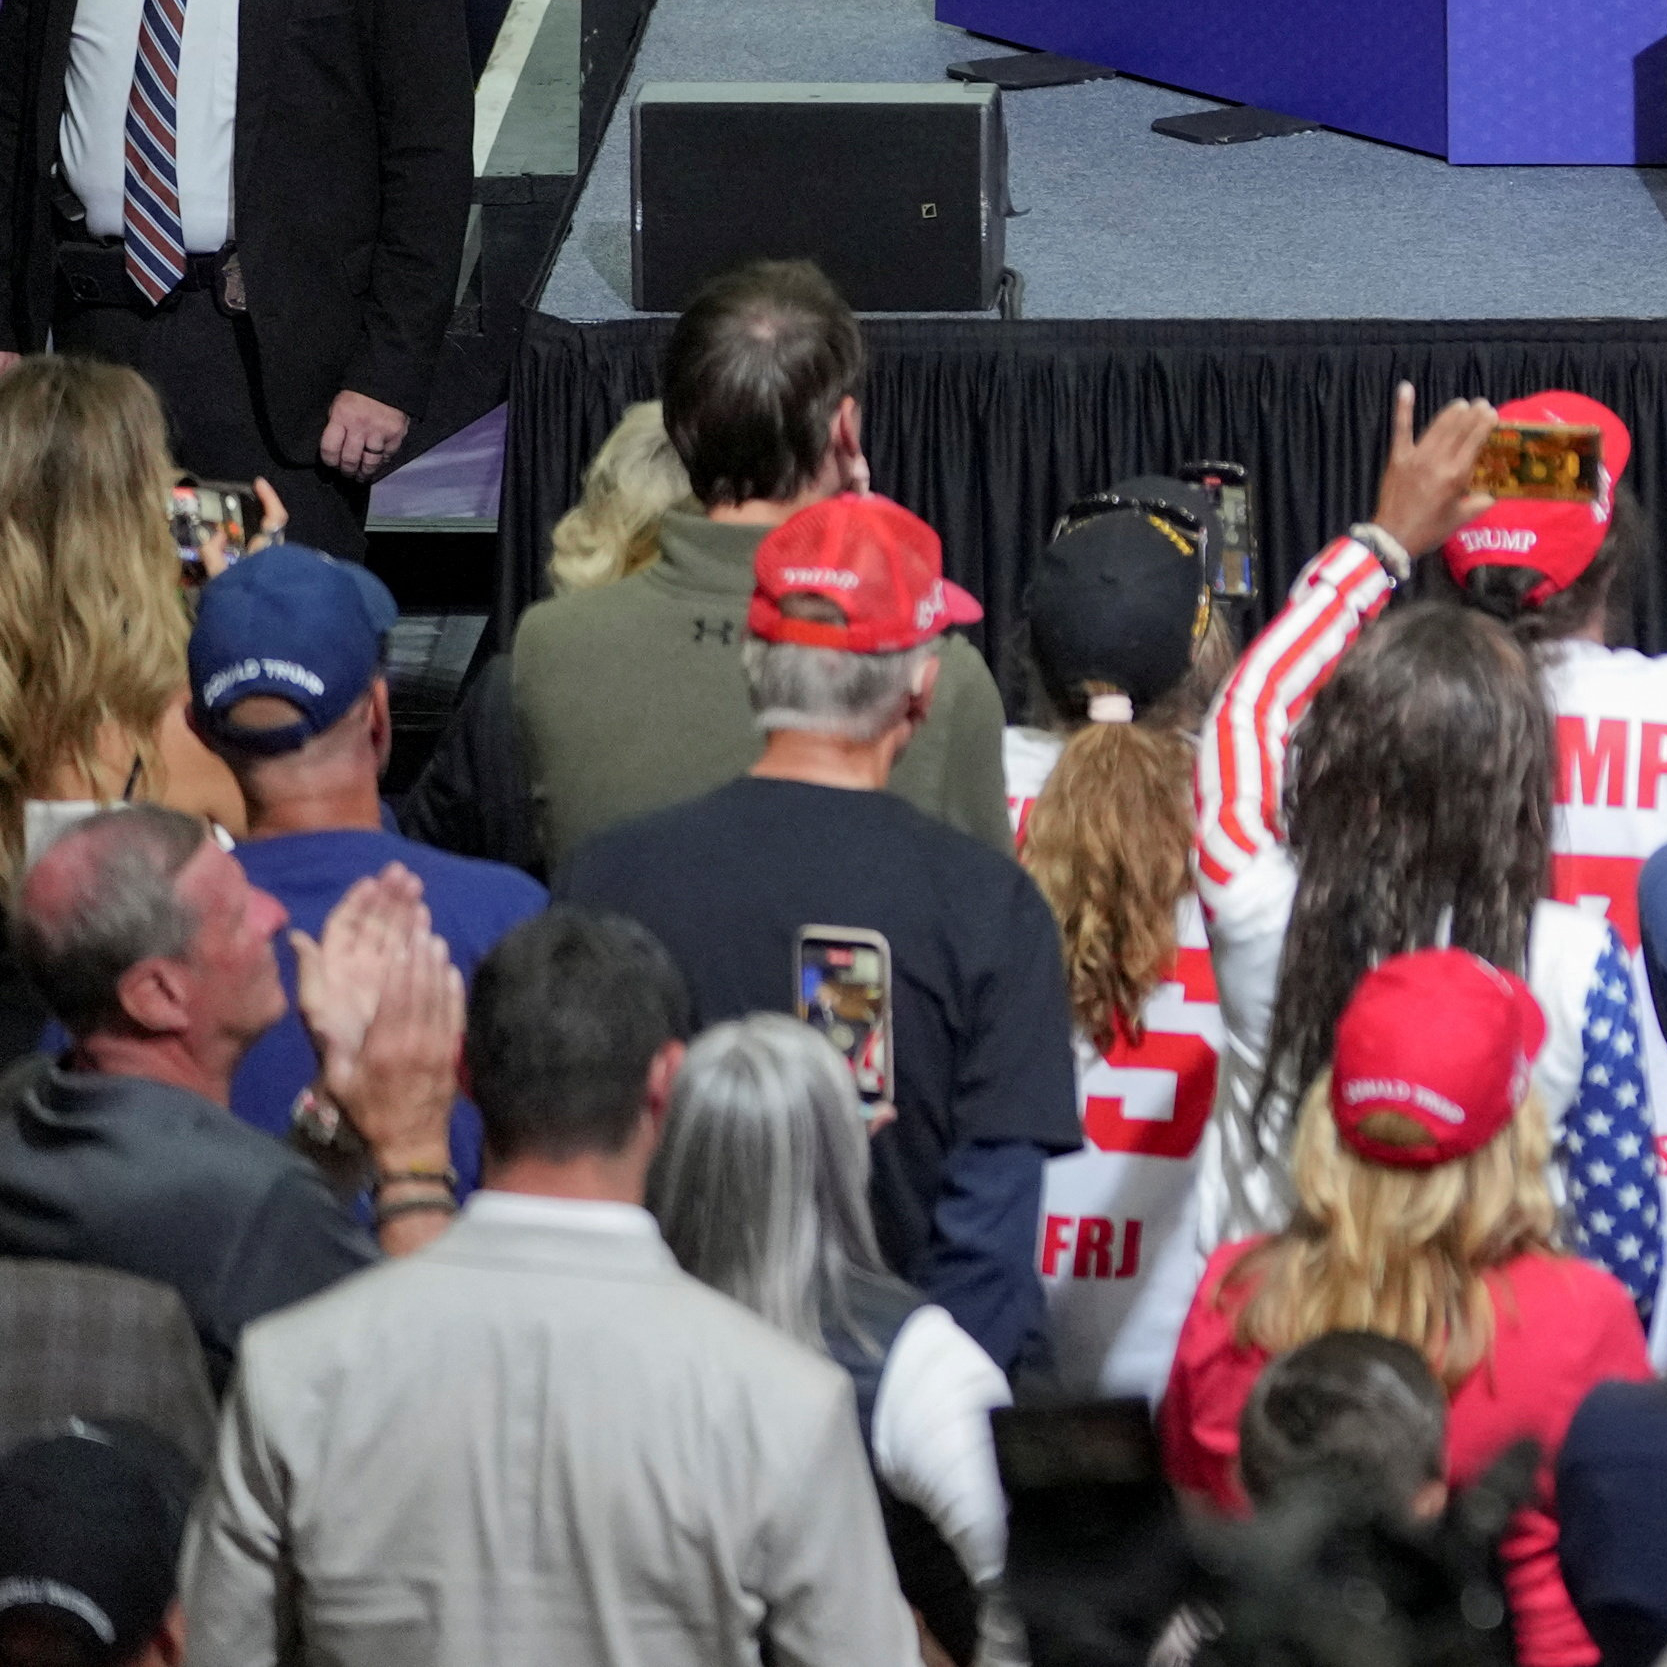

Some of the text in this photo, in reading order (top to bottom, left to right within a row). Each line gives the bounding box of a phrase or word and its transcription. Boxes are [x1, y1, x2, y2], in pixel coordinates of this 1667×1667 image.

[1459, 526, 1538, 554] TRUMP
[203, 657, 325, 708] DONALD TRUMP
